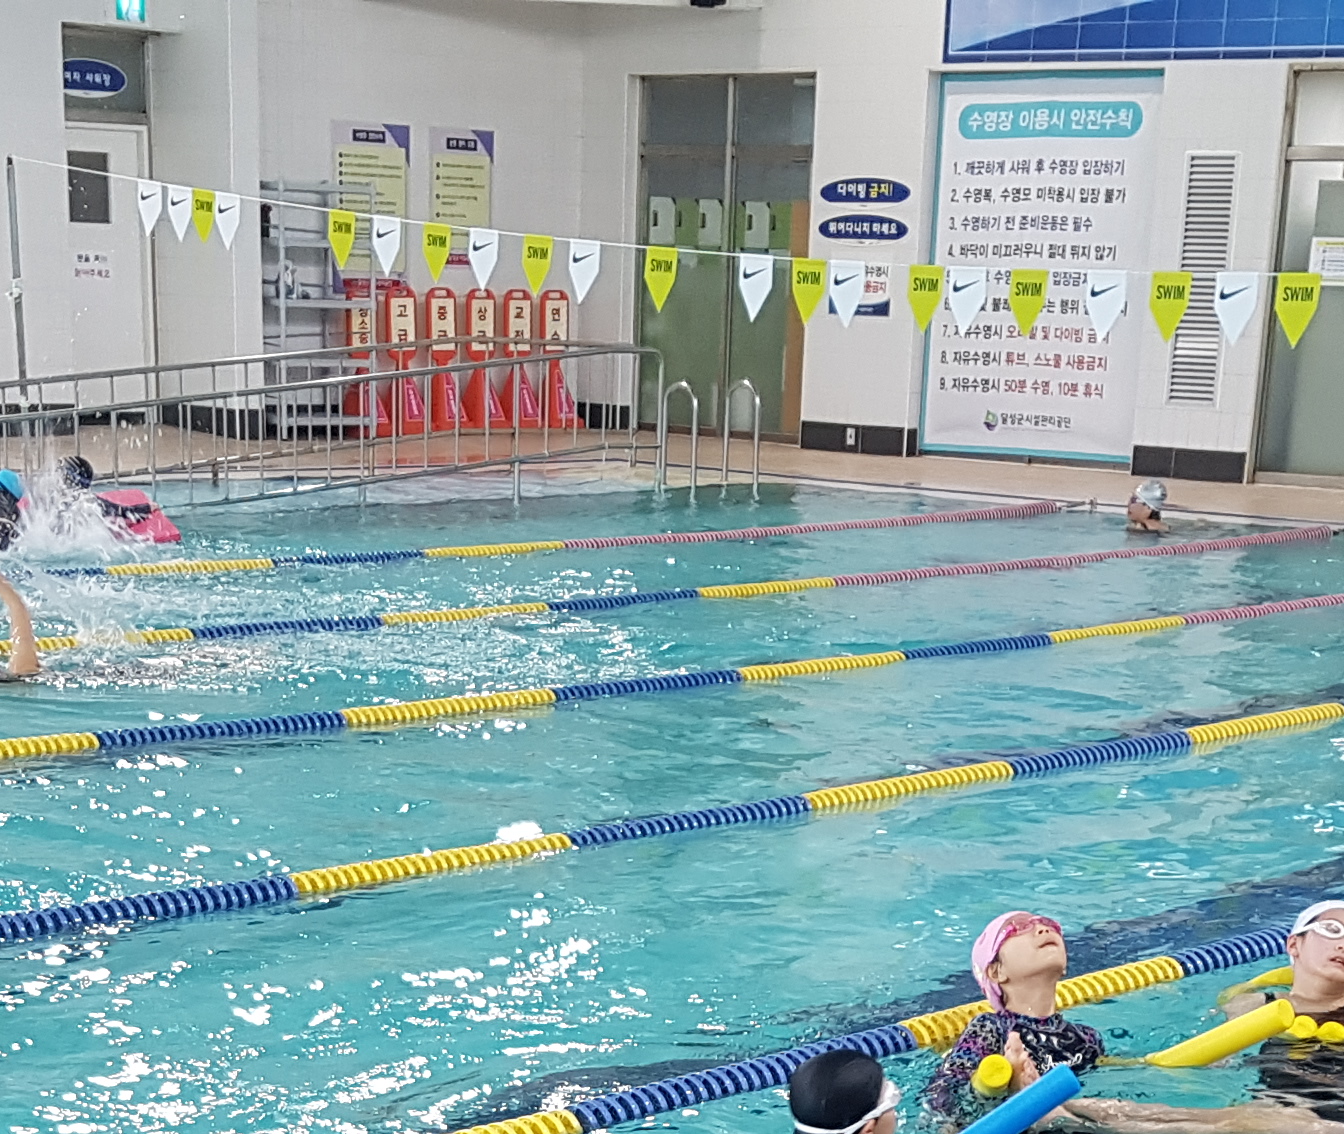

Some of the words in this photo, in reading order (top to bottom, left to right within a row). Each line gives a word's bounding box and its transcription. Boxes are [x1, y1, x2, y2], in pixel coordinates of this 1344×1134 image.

[968, 110, 1014, 132] 수영장
[1019, 108, 1065, 131] 이용시
[1070, 107, 1133, 130] 안전수칙
[964, 159, 1006, 176] 깨끗하게
[1008, 158, 1031, 176] 샤워
[1034, 157, 1045, 175] 후
[1049, 158, 1079, 176] 수영장
[1082, 159, 1126, 176] 입장하기
[837, 182, 867, 199] 다이빙
[1000, 187, 1032, 203] 수영모
[1036, 187, 1075, 203] 미착용시
[1079, 187, 1100, 204] 입장
[960, 215, 1001, 232] 수영하기
[1004, 216, 1016, 231] 전
[1019, 214, 1069, 232] 준비운동은
[1073, 216, 1093, 232] 필수
[426, 232, 447, 248] SWIM
[527, 246, 549, 260] SWIM
[959, 243, 989, 260] 바닥이
[992, 242, 1044, 260] 미끄러우니
[1047, 244, 1067, 260] 절대
[650, 258, 673, 274] SWIM
[796, 270, 821, 286] SWIM
[912, 277, 939, 292] SWIM
[1014, 281, 1042, 297] SWIM
[1156, 284, 1185, 301] SWIM
[1283, 286, 1314, 303] SWIM
[942, 324, 951, 338] 7.
[1053, 327, 1084, 344] 다이빙
[952, 350, 1002, 367] 자유수영시
[1065, 354, 1108, 372] 사용금지
[951, 377, 1001, 393] 자유수영시
[1004, 378, 1027, 395] 50분
[1058, 381, 1079, 398] 10분
[1082, 382, 1104, 399] 휴식
